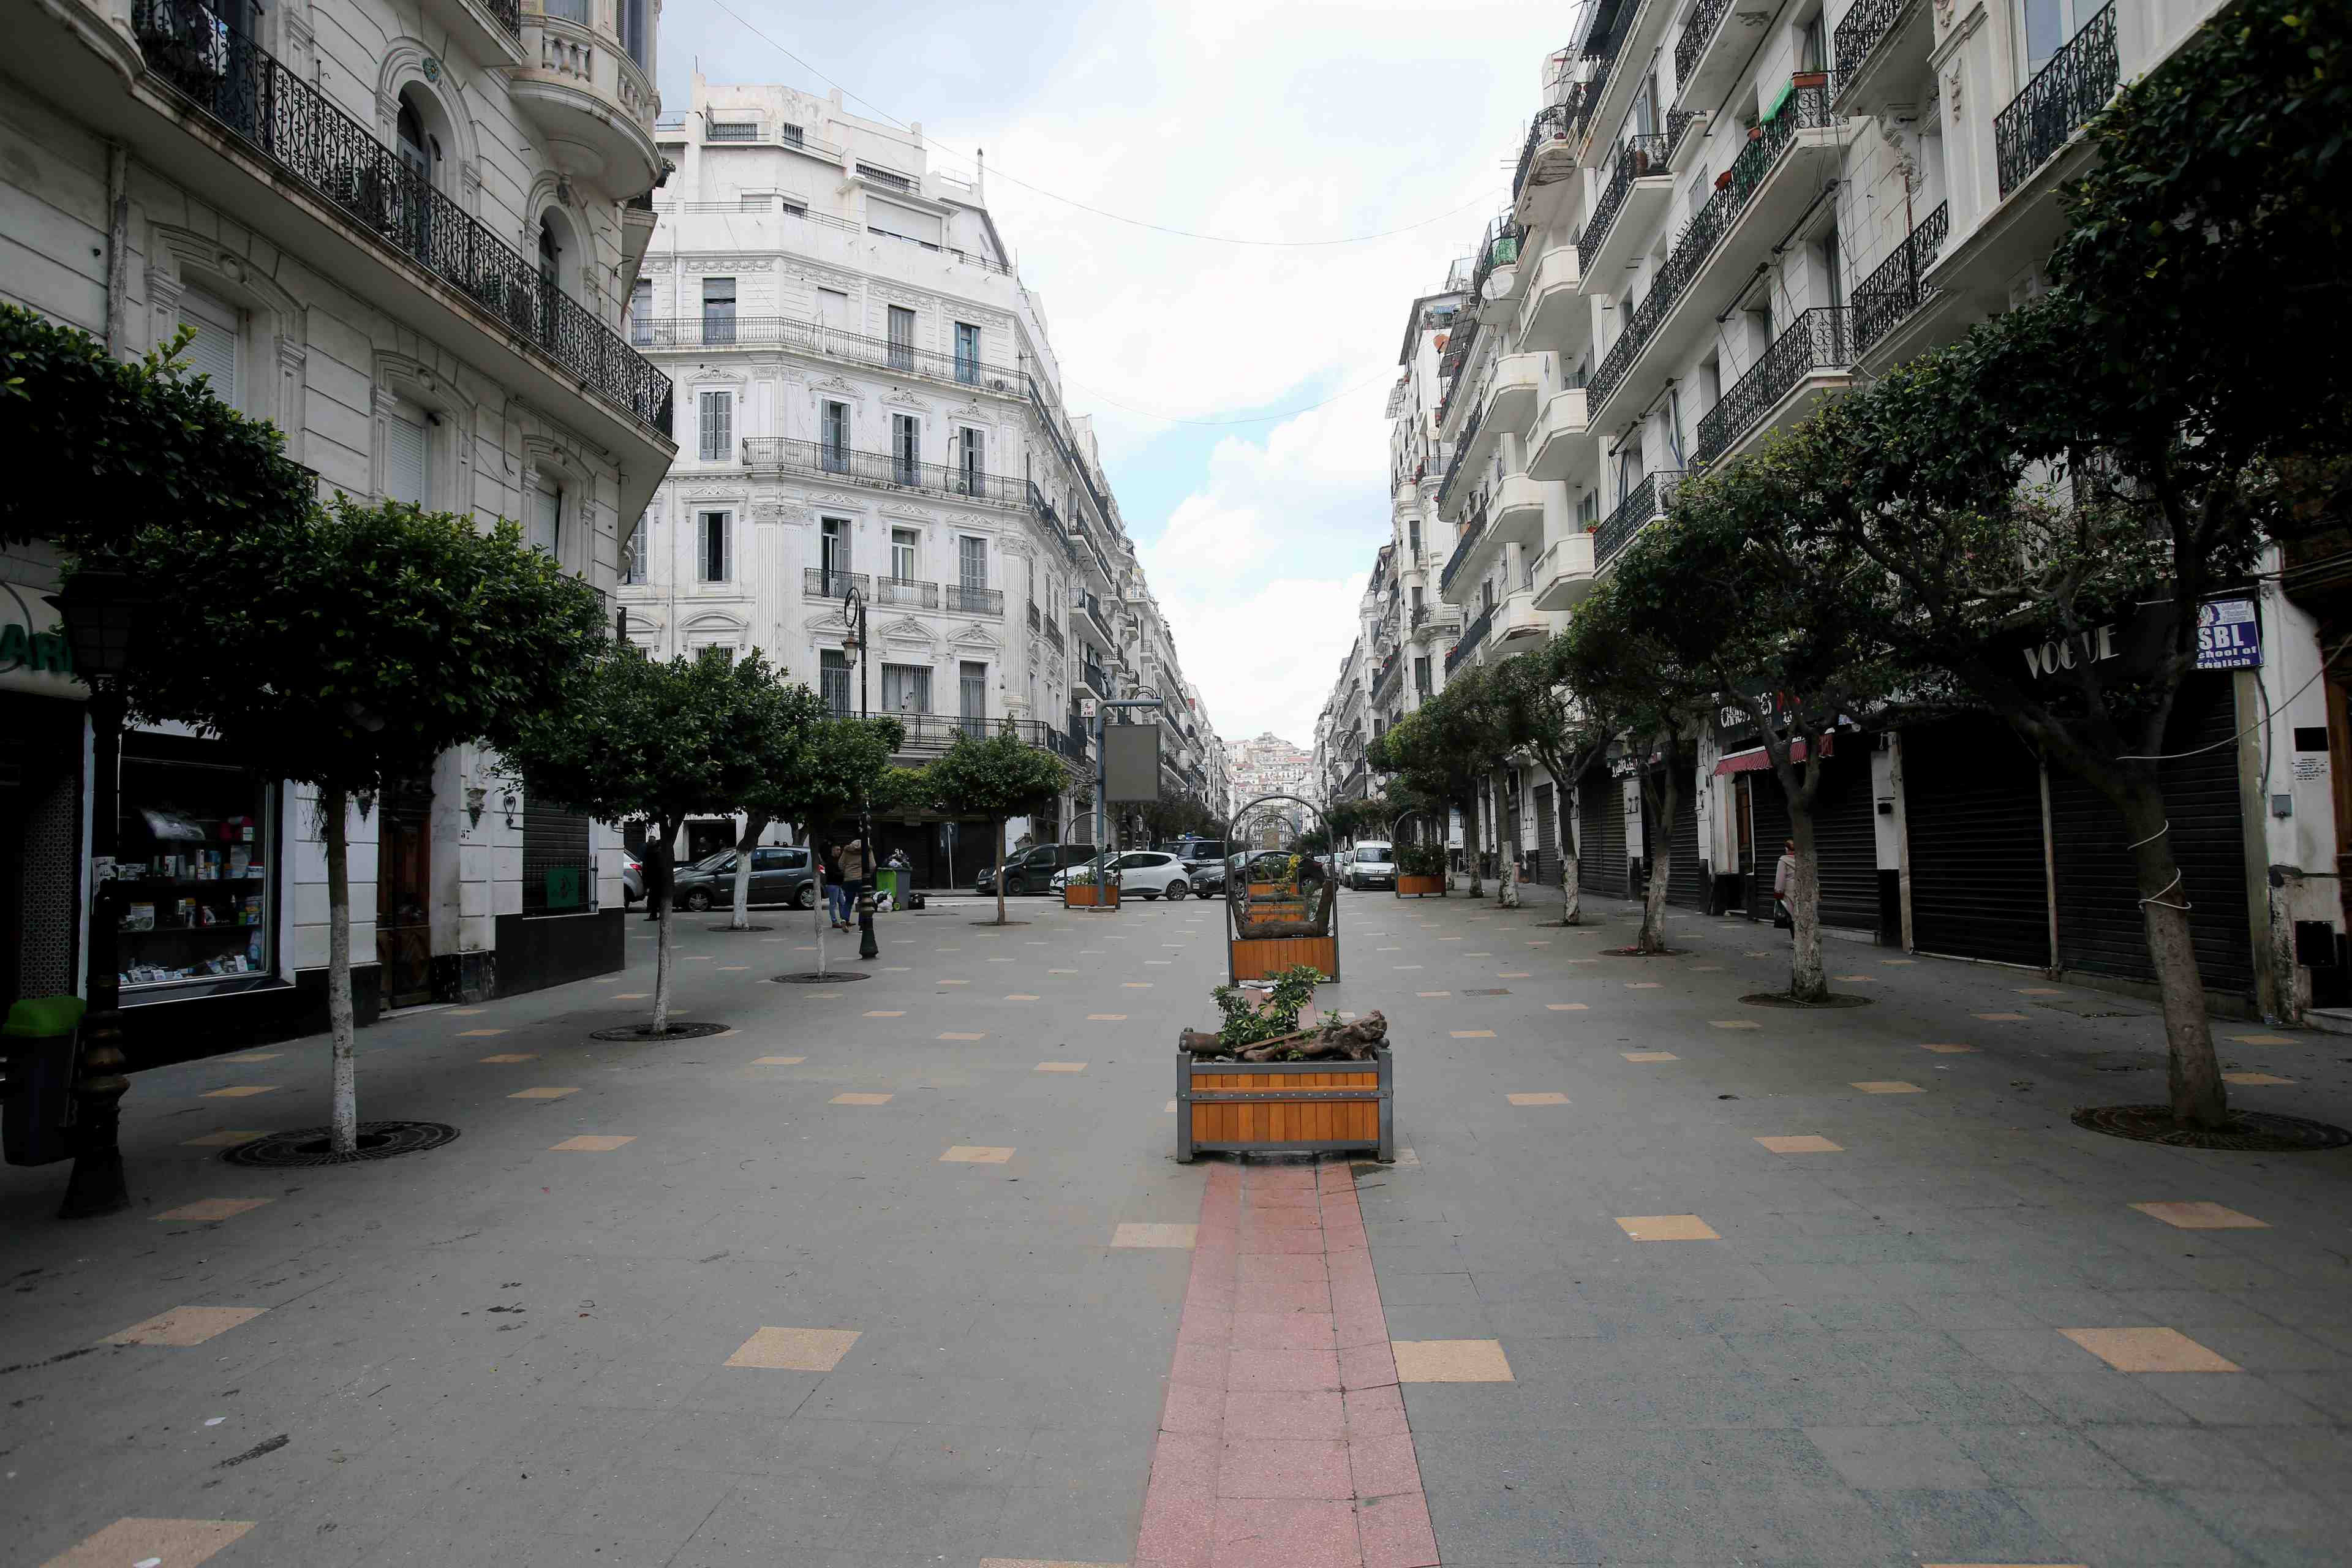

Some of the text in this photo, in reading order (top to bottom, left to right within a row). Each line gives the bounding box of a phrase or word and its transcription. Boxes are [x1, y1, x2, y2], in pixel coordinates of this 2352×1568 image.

[2198, 625, 2244, 649] SBL
[2242, 646, 2257, 655] of
[2196, 658, 2251, 669] English
